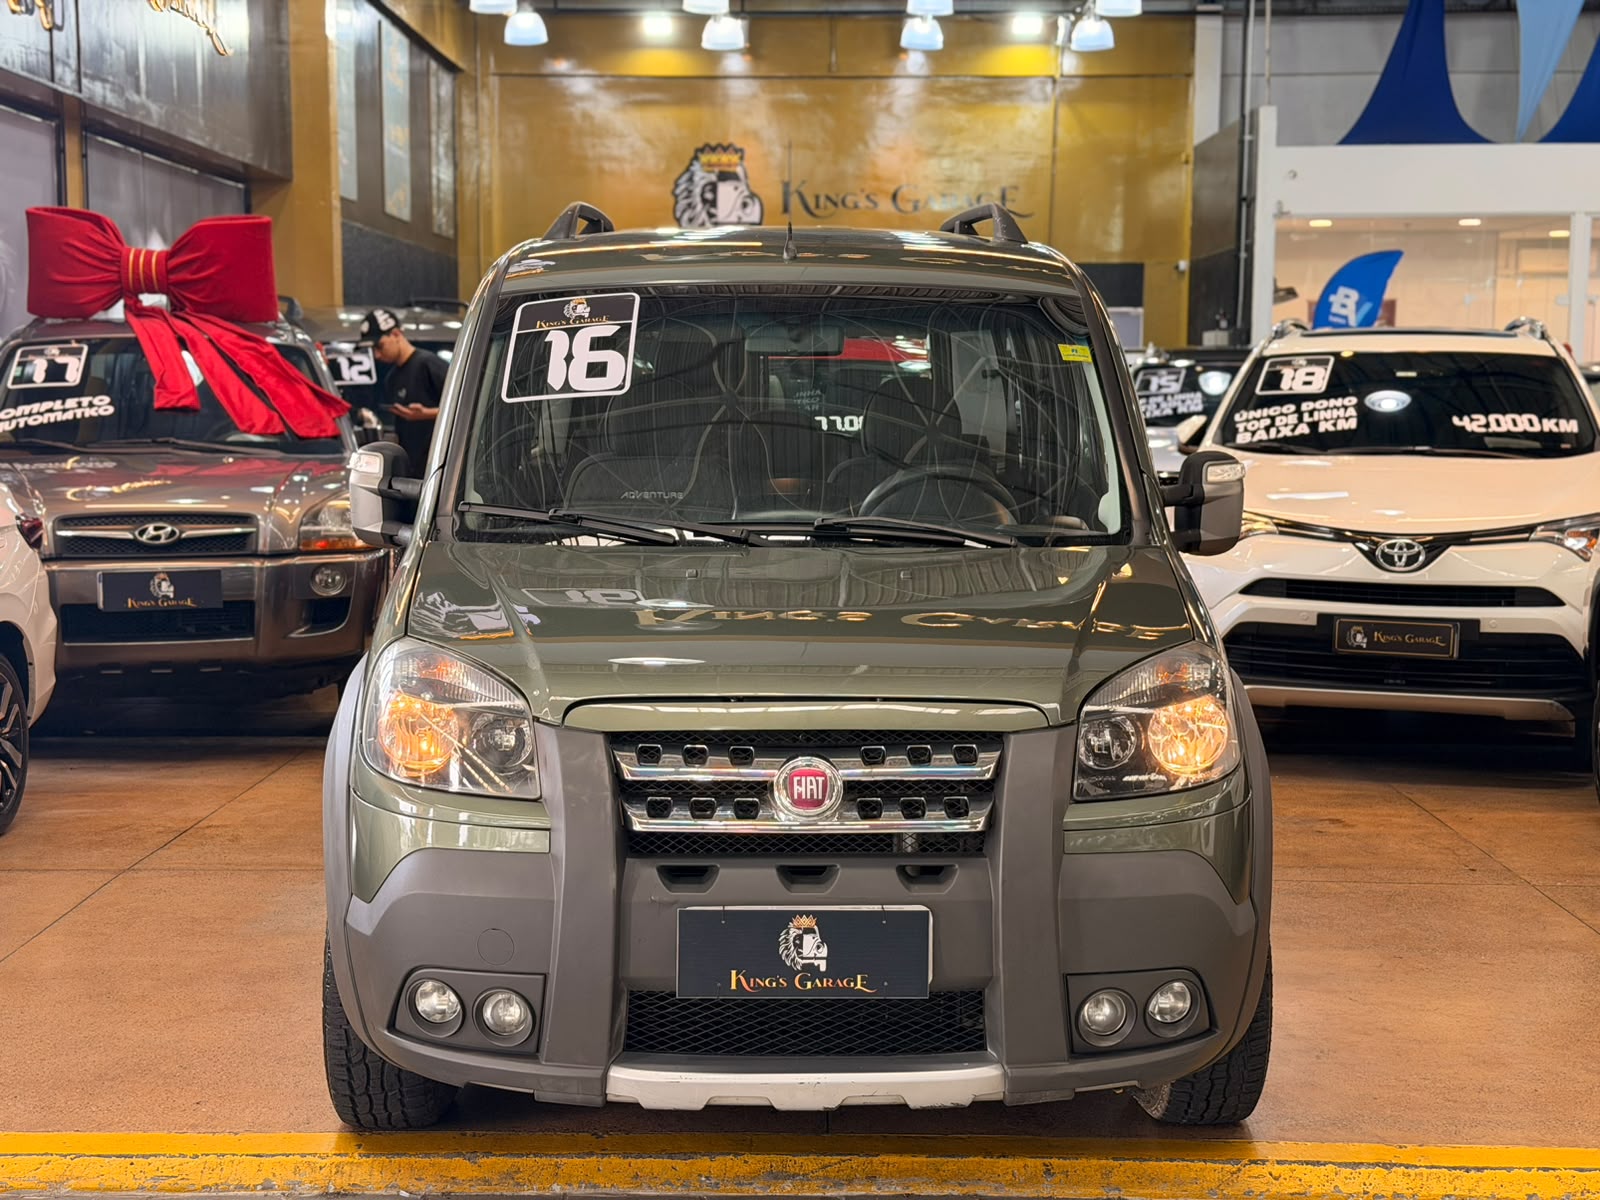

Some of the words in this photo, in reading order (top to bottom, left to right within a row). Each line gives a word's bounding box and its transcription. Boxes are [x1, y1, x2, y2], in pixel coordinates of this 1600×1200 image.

[780, 178, 879, 219] KING'S
[32, 356, 80, 383] 17
[336, 354, 371, 382] 12
[544, 324, 626, 391] 16
[1280, 366, 1326, 391] 18
[0, 395, 111, 420] OMPLETO
[1301, 396, 1358, 412] DONO
[1235, 418, 1271, 432] TOP
[1275, 413, 1298, 427] DE
[1303, 407, 1358, 423] LINHA
[1236, 423, 1310, 444] BAIXA
[1318, 417, 1358, 432] KM
[620, 490, 684, 500] ADVENTURE
[793, 776, 825, 799] FIAT
[730, 970, 788, 993] KING'S
[794, 973, 877, 993] GARAGE
